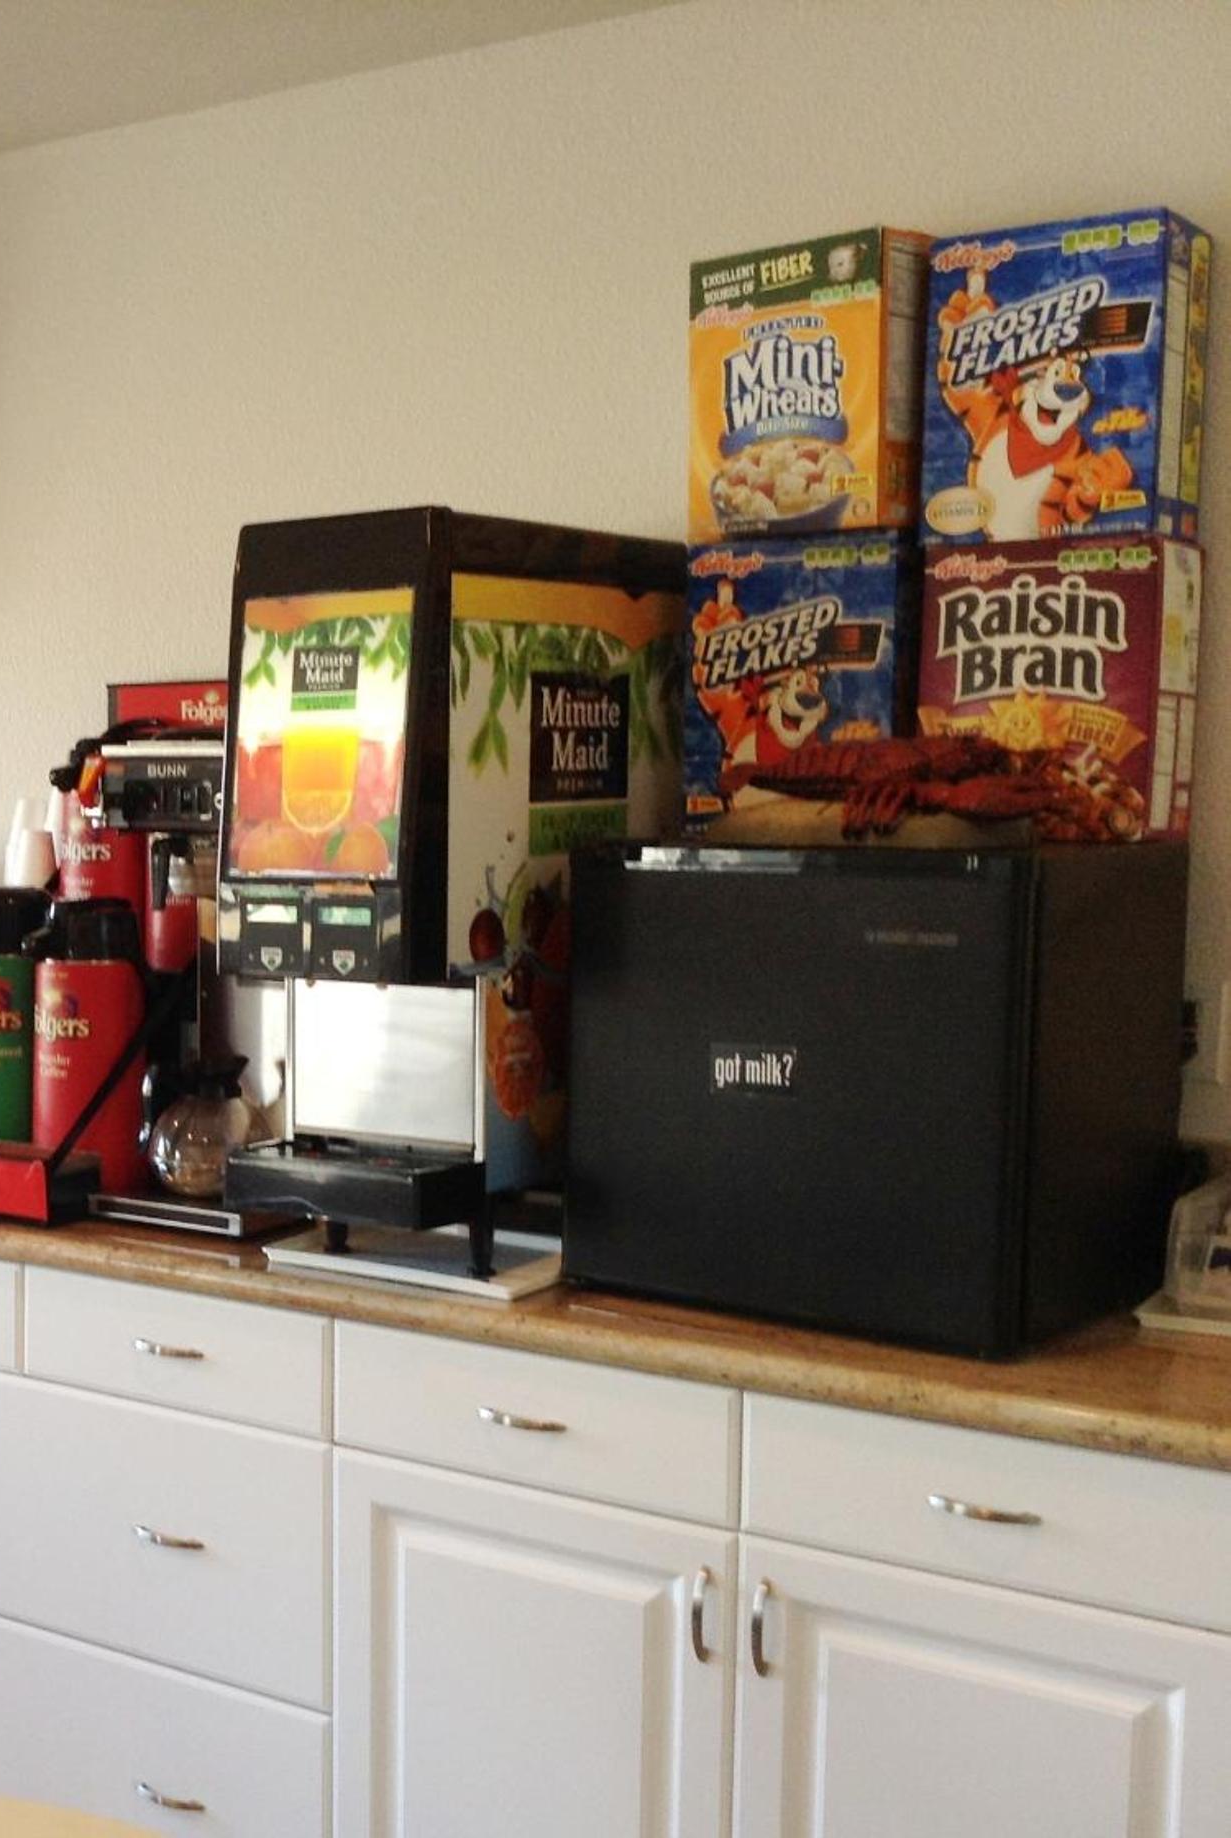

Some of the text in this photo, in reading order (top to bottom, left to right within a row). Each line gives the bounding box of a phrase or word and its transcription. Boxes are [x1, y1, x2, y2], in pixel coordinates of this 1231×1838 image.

[701, 262, 756, 290] EXCELLENT
[760, 250, 814, 285] FIBER
[703, 280, 755, 305] SOURCE OF
[951, 281, 1101, 358] FROSTED
[955, 315, 1081, 383] FLAKES
[731, 385, 838, 430] Wheats
[706, 600, 836, 661] FROSTED
[941, 577, 1122, 650] Raisin
[300, 651, 353, 670] Minute
[306, 667, 344, 683] Maid
[709, 631, 819, 686] FLAKES
[959, 644, 1099, 698] Bran
[541, 685, 621, 728] Minute
[147, 763, 187, 778] BUNN
[551, 731, 609, 771] Maid
[715, 1052, 793, 1089] got milk?
